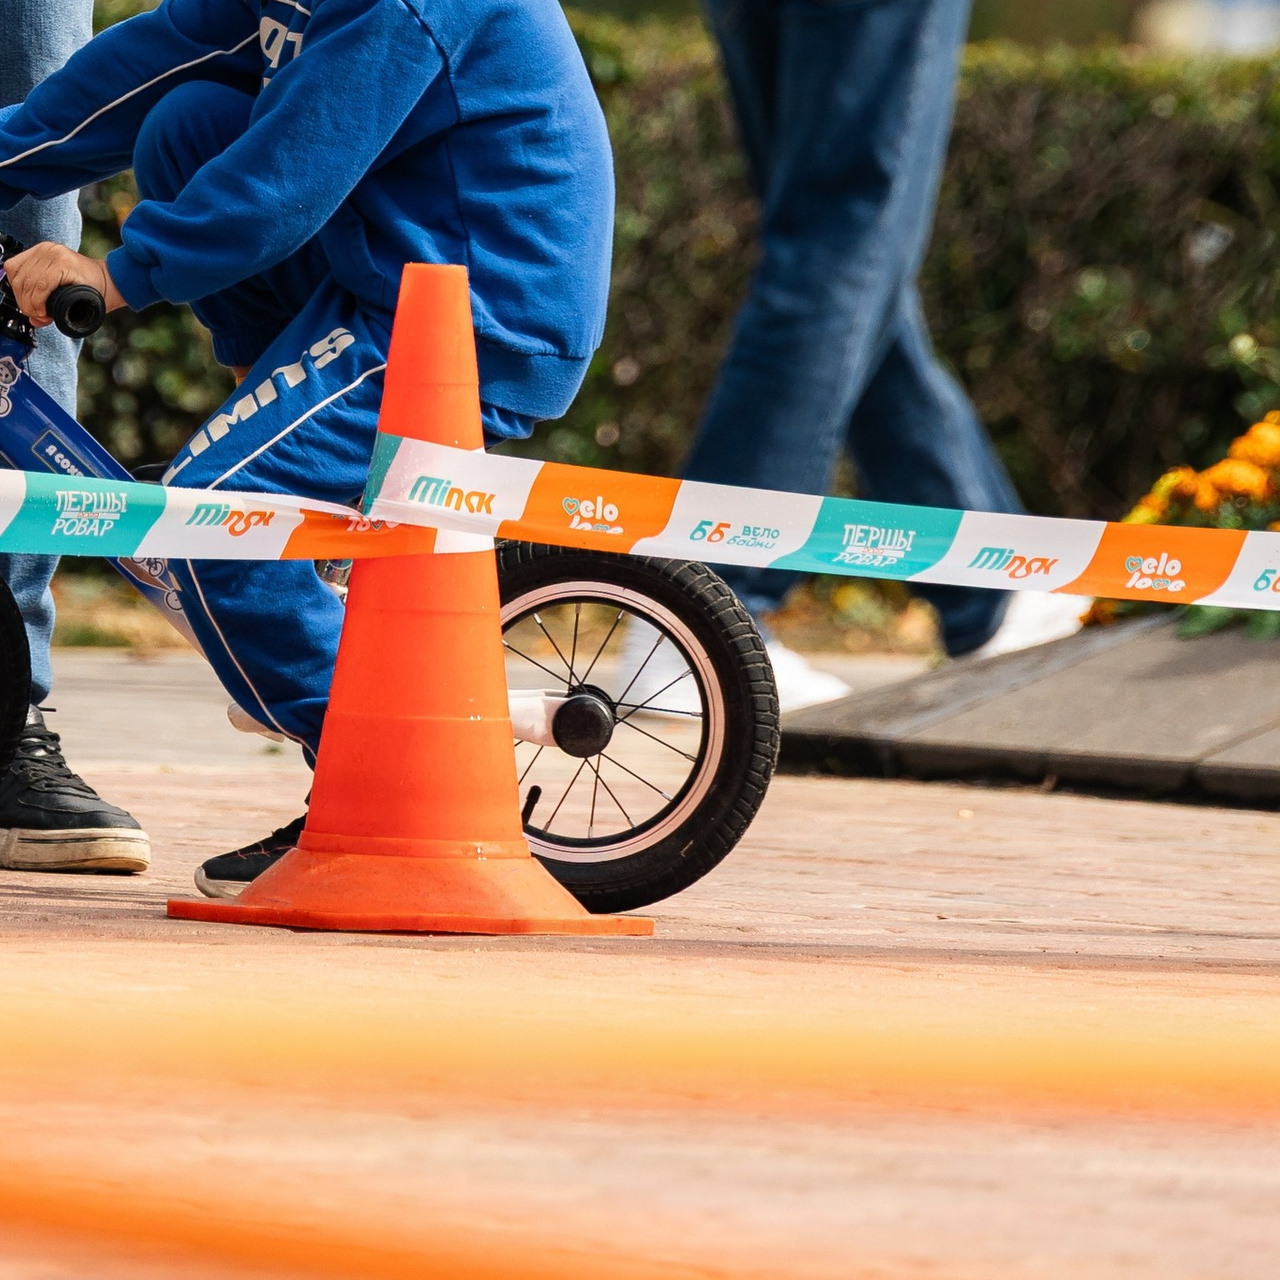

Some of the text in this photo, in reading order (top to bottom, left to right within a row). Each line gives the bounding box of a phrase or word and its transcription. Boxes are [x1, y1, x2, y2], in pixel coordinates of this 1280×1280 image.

[56, 491, 128, 513] ПЕРШЫ
[51, 518, 114, 536] РОВАР
[727, 535, 775, 550] байки
[842, 524, 916, 551] ПЕРШЫ
[832, 552, 898, 567] РОВАР
